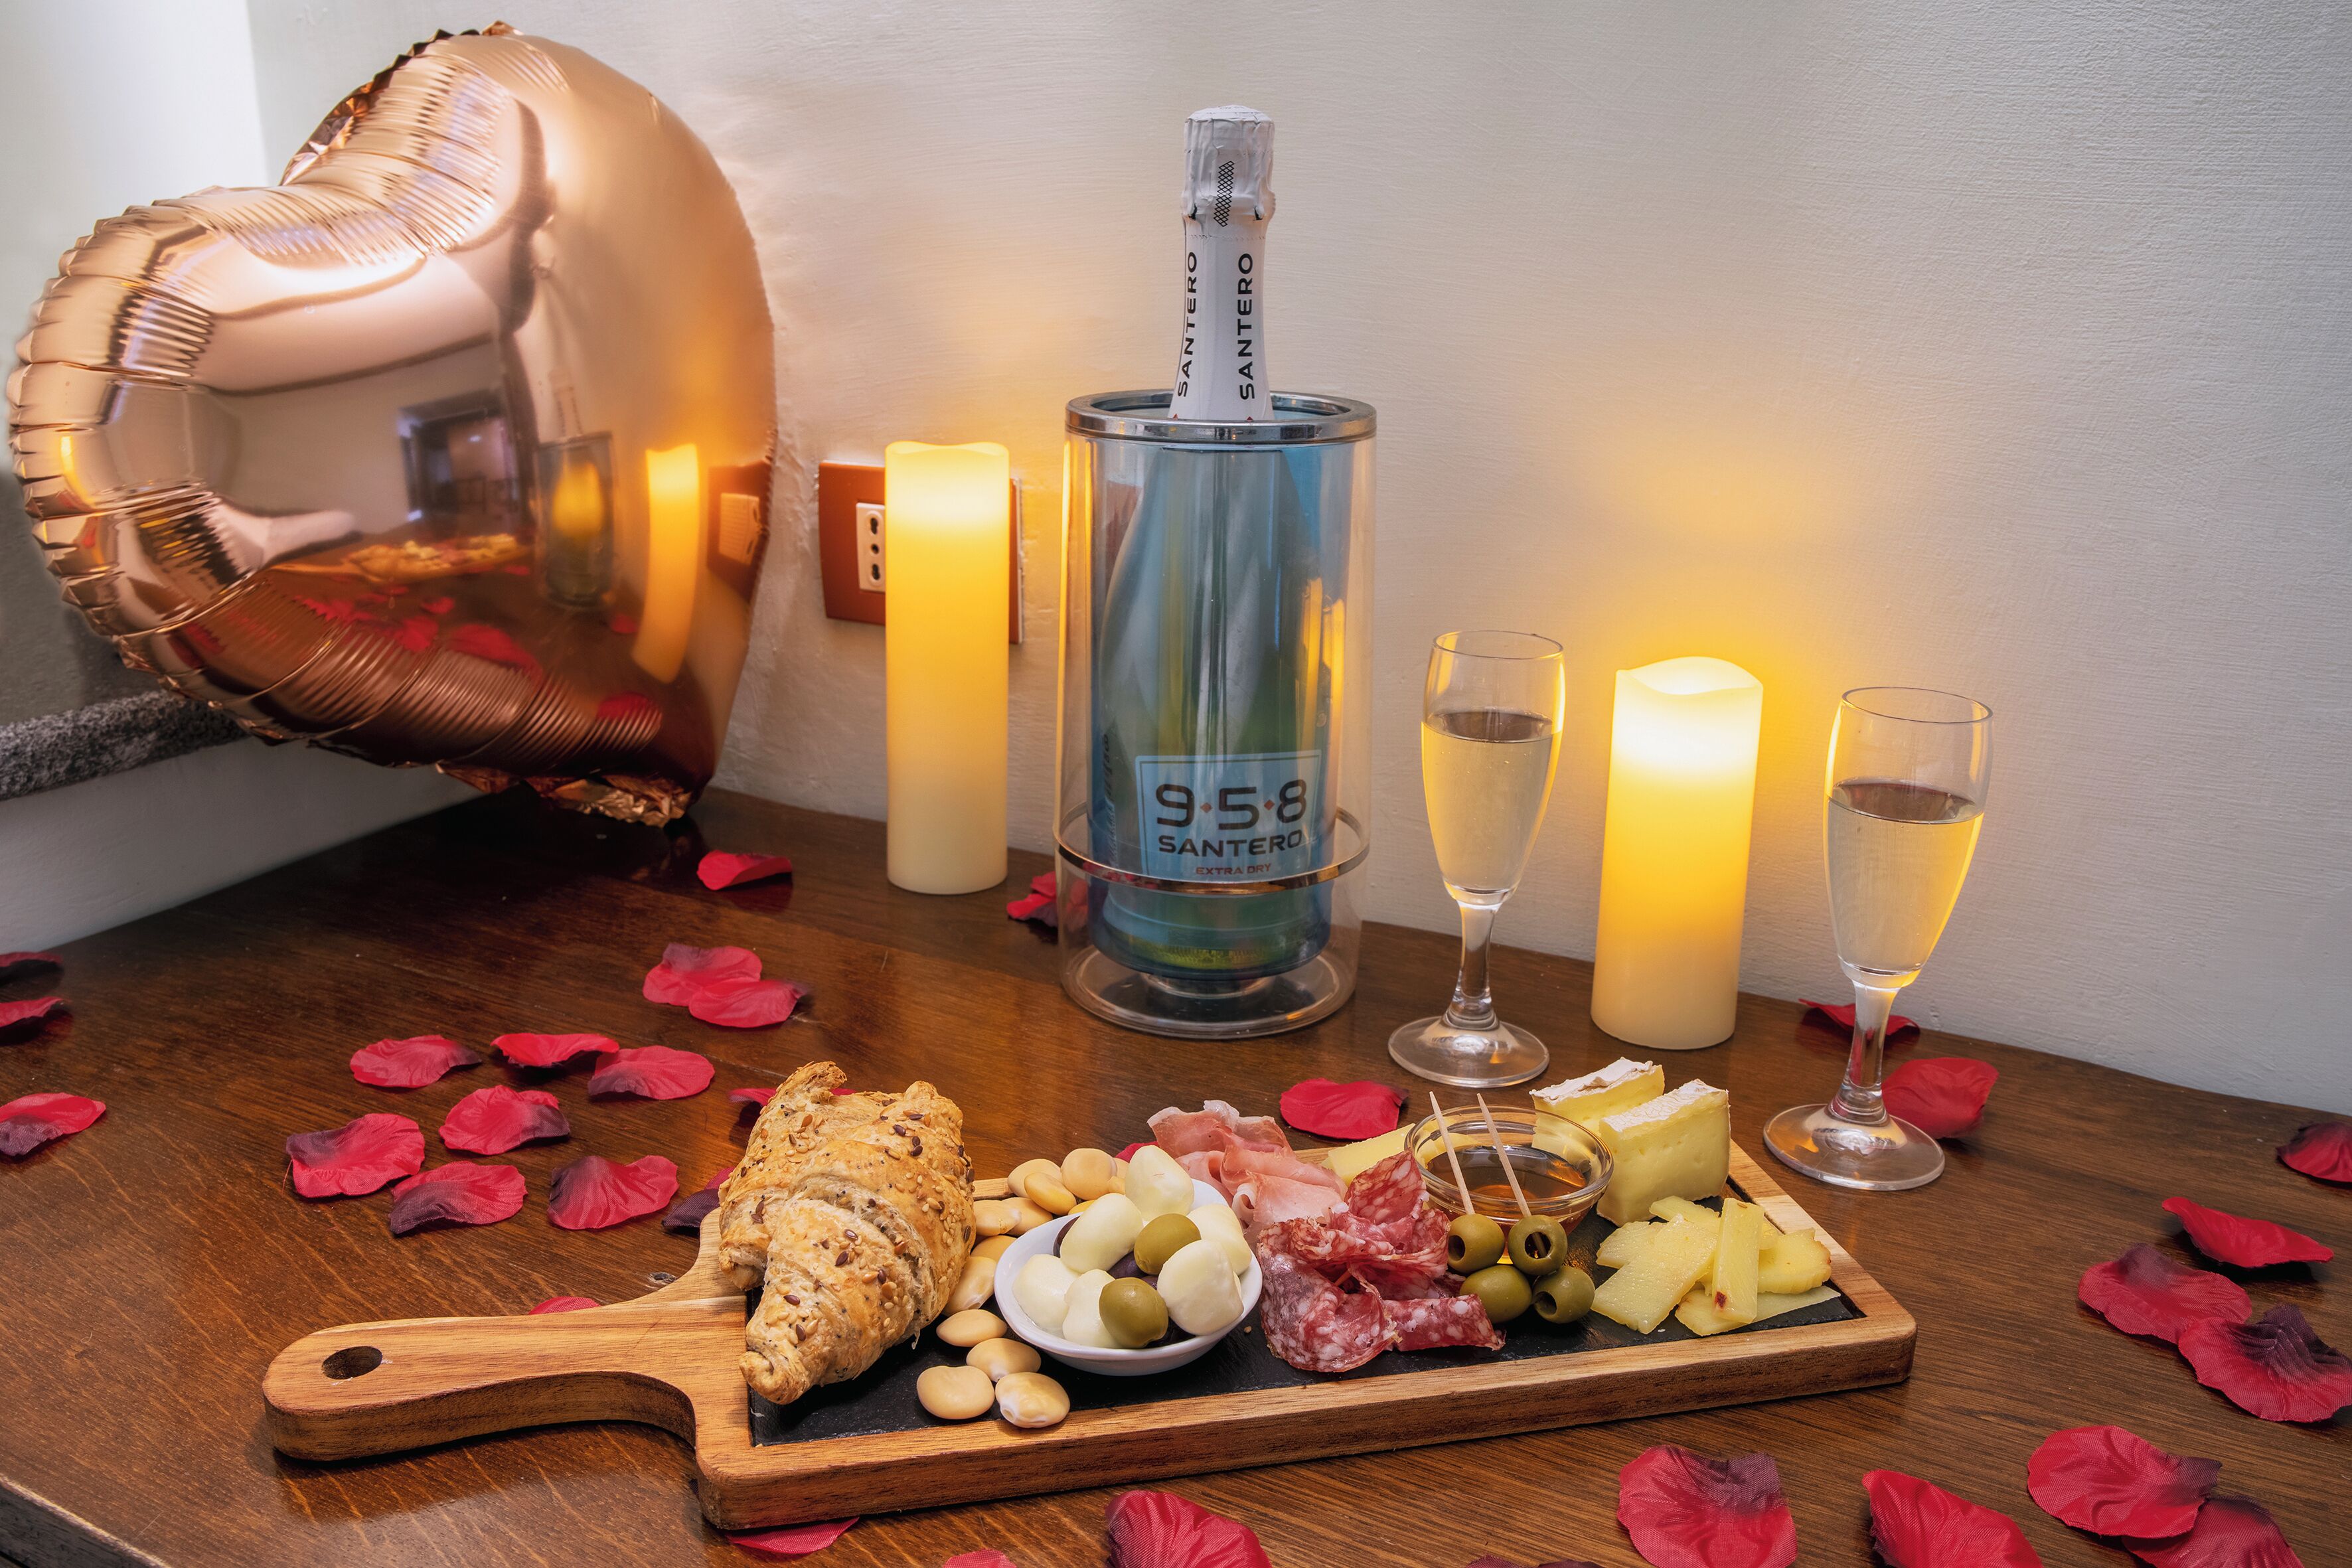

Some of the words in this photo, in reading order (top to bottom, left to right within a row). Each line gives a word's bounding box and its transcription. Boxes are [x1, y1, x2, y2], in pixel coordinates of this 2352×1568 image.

[1178, 252, 1197, 397] SANTERO
[1237, 253, 1255, 400] SANTERO
[1158, 830, 1302, 857] SANTERO
[1196, 866, 1243, 876] EXTRA
[1247, 863, 1271, 874] DRY
